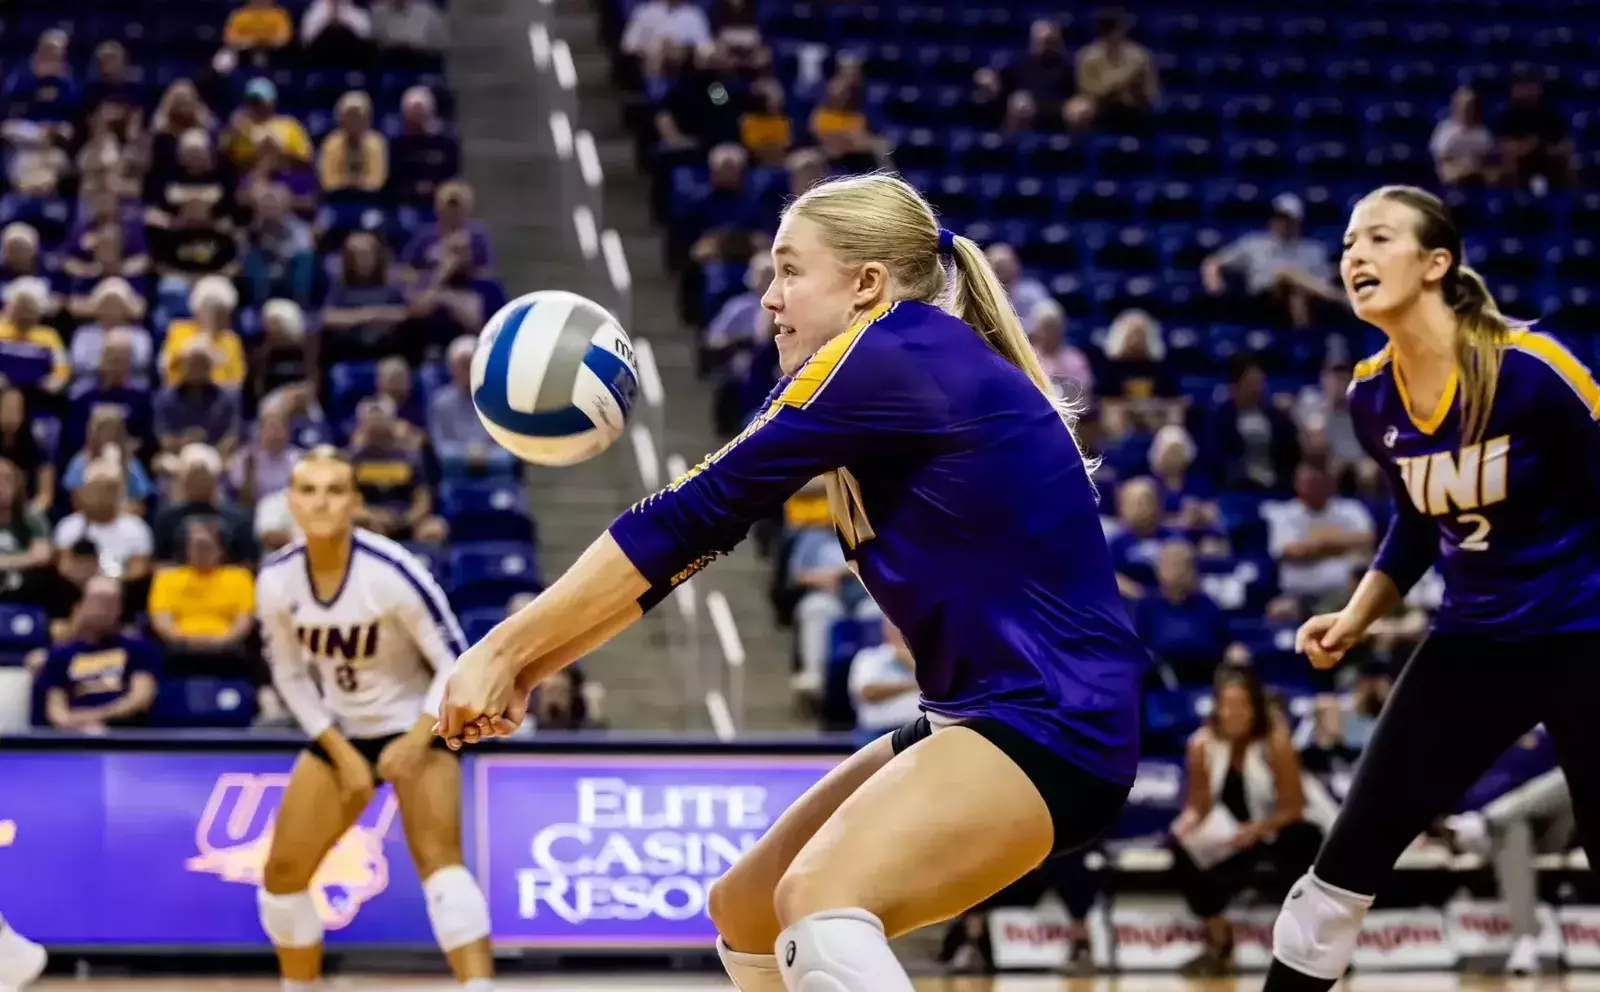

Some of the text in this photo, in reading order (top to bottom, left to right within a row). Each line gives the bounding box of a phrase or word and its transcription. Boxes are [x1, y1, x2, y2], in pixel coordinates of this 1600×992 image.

[1457, 513, 1491, 551] 2
[577, 776, 768, 829] ELITE
[531, 822, 757, 876] CASIN
[515, 867, 712, 924] RESO
